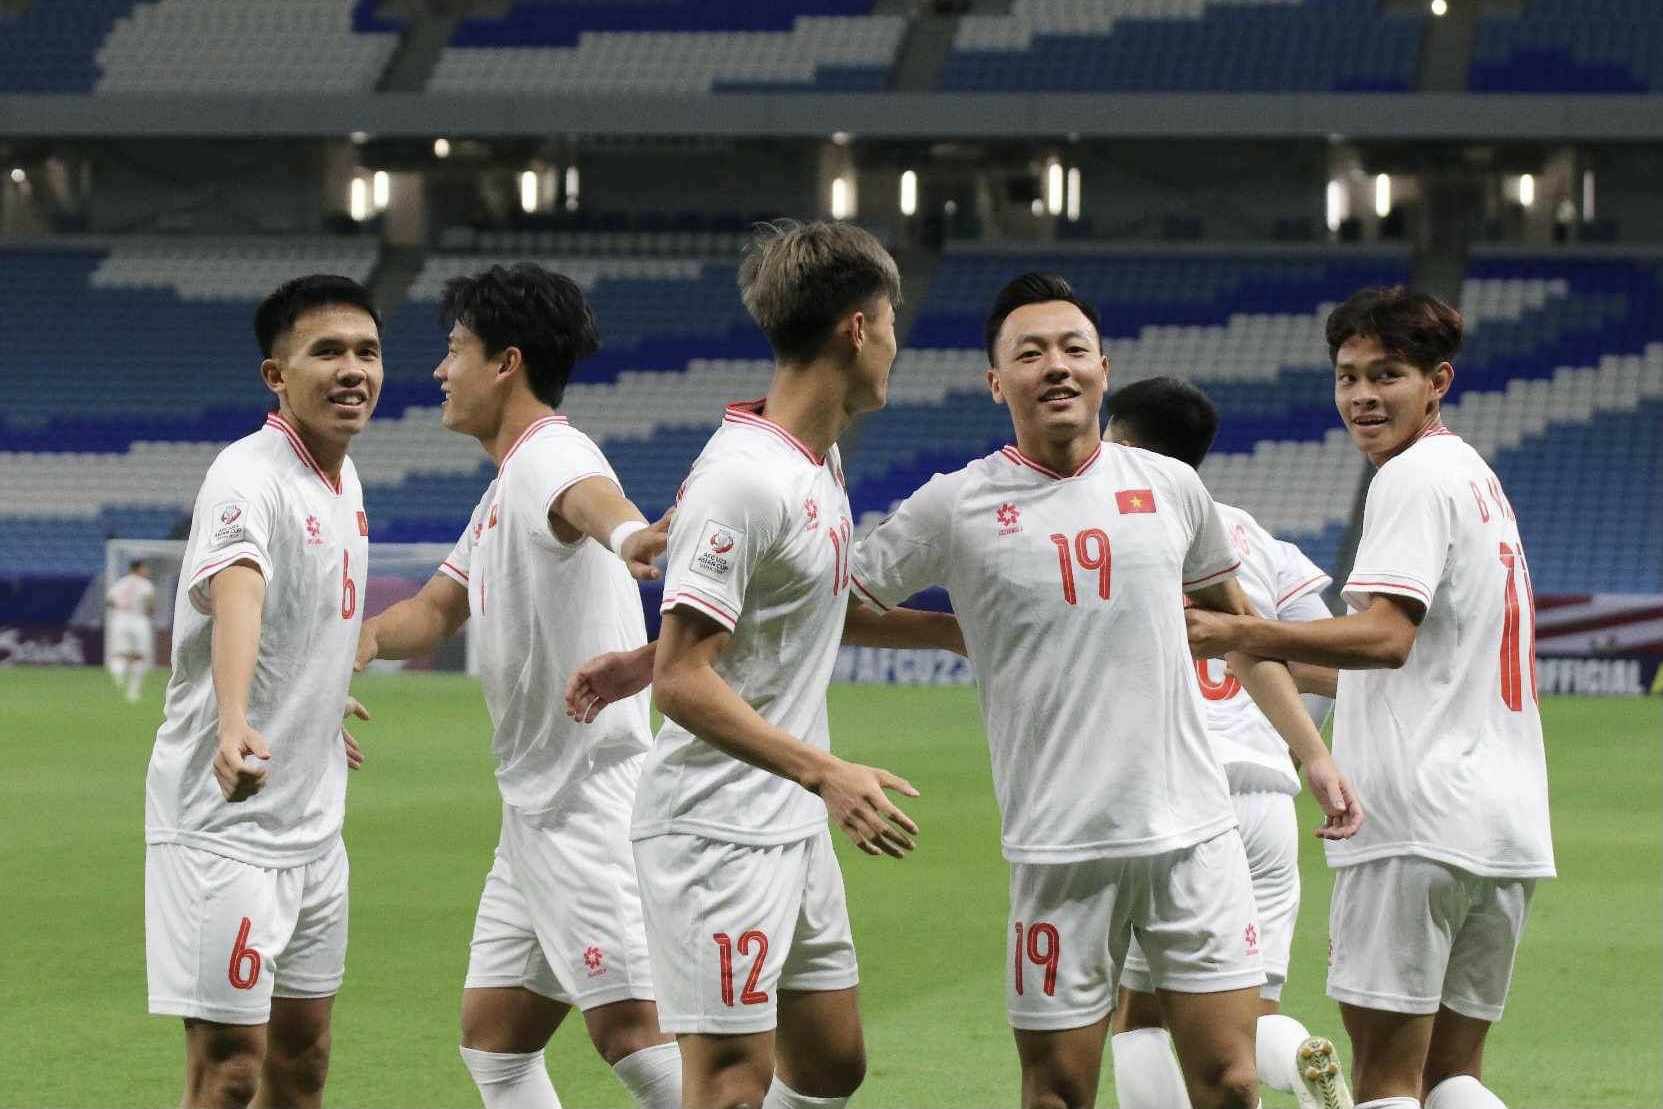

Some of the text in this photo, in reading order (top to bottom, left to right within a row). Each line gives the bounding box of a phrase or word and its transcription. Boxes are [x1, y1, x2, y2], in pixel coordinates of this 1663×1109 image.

[341, 548, 356, 620] 6
[1049, 527, 1112, 606] 19
[229, 916, 261, 989] 6
[712, 930, 769, 1007] 12
[1014, 921, 1060, 997] 19
